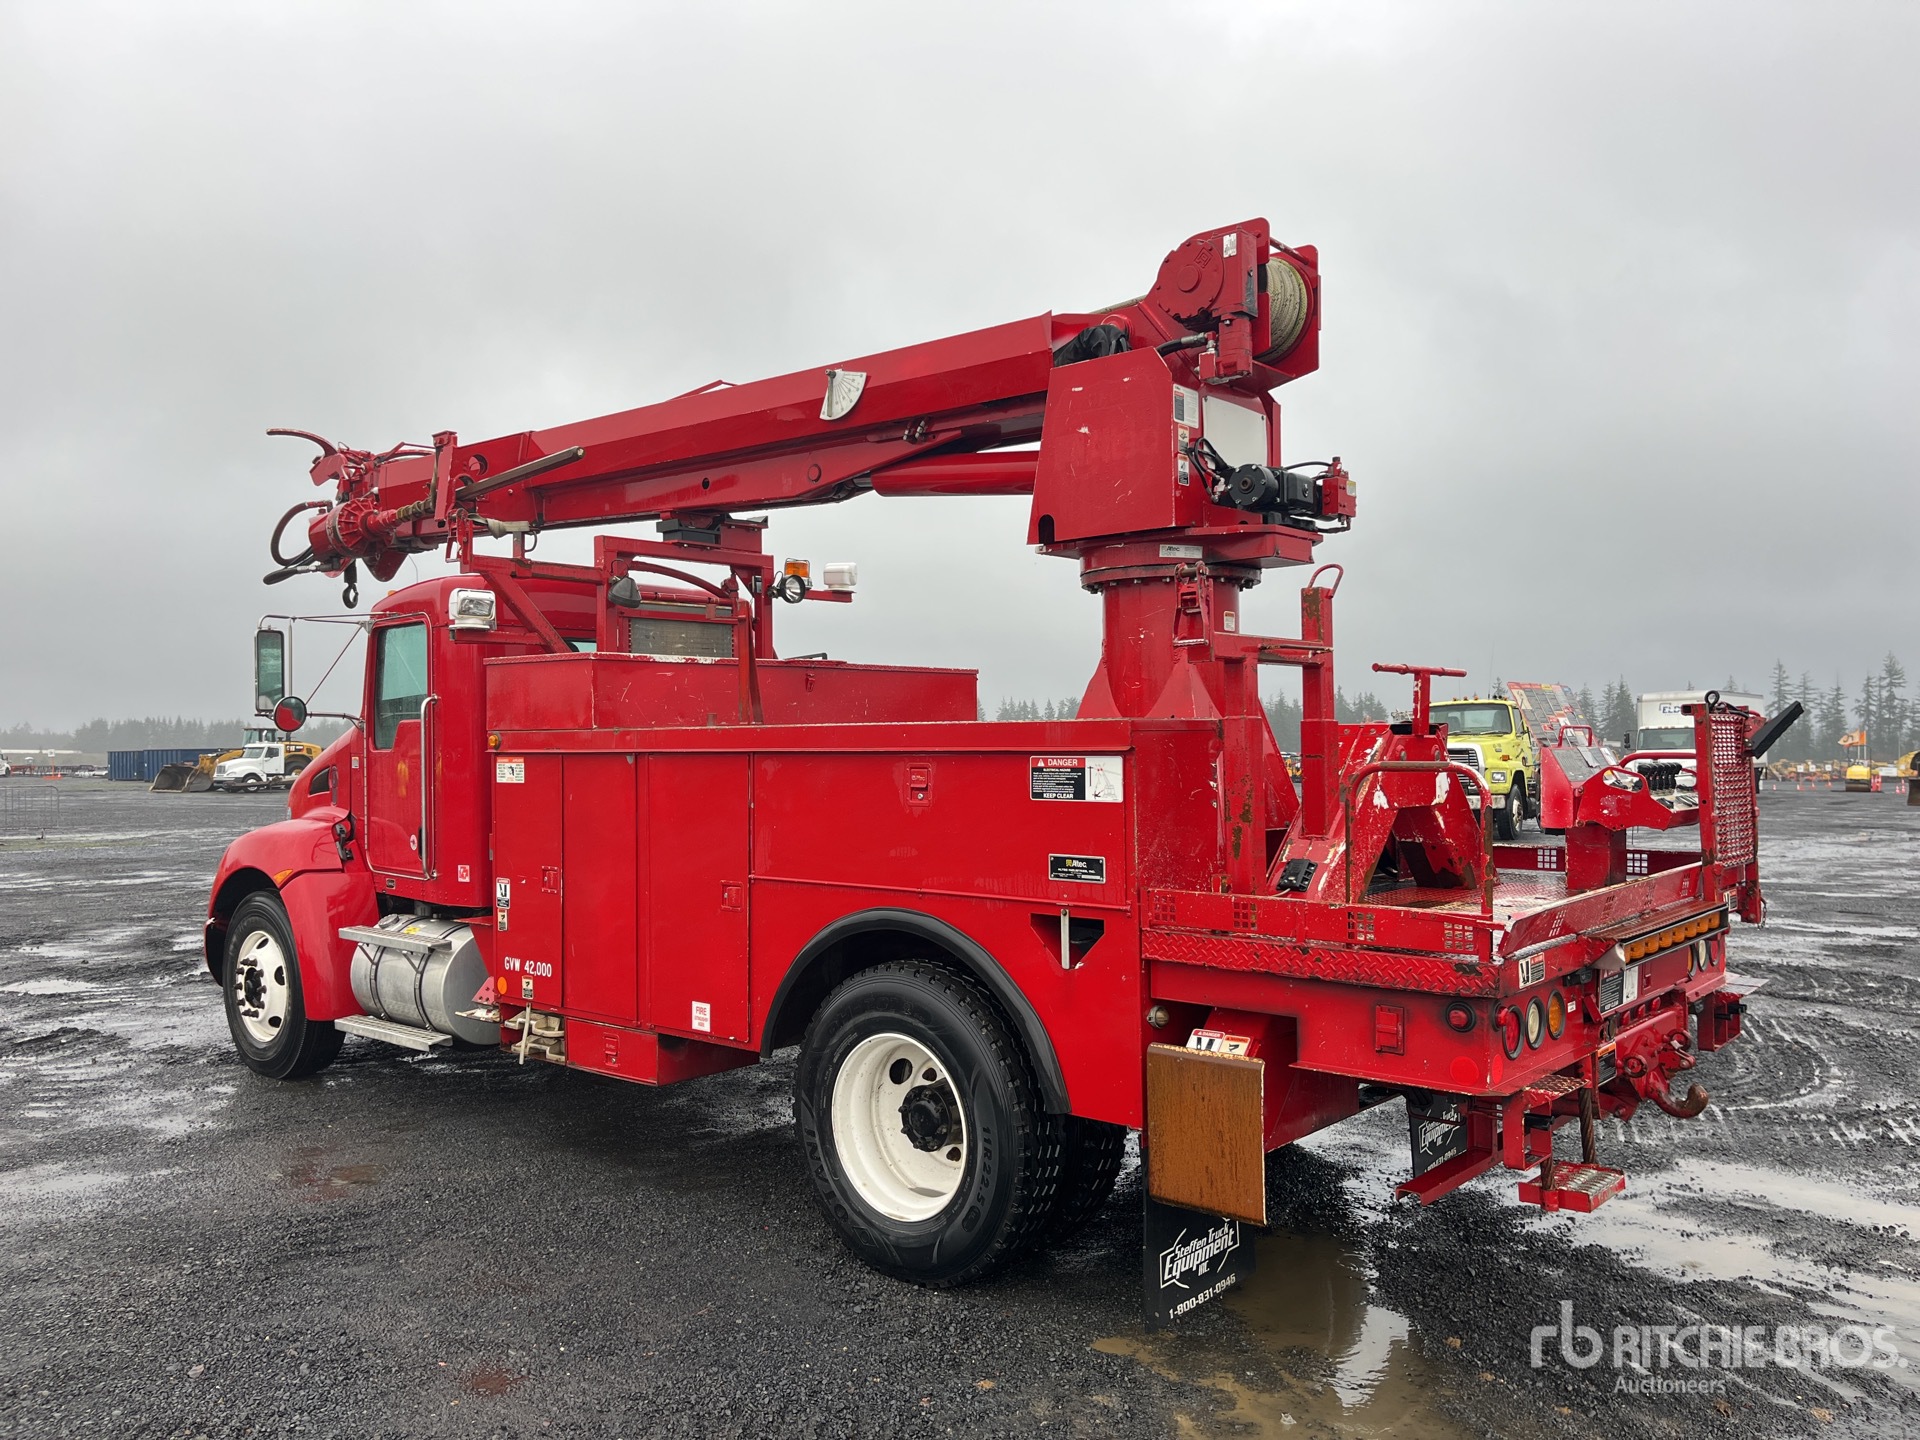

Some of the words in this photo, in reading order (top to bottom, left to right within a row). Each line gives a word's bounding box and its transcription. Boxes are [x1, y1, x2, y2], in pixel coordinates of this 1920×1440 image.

[1047, 758, 1078, 766] DANGER
[504, 956, 520, 971] GVW
[524, 960, 552, 977] 42,000
[695, 1006, 707, 1016] FIRE
[1164, 1228, 1235, 1281] Equipment
[1174, 1237, 1207, 1260] Steffen
[1208, 1222, 1230, 1243] Truck
[1169, 1272, 1236, 1319] 1-800-831-0946
